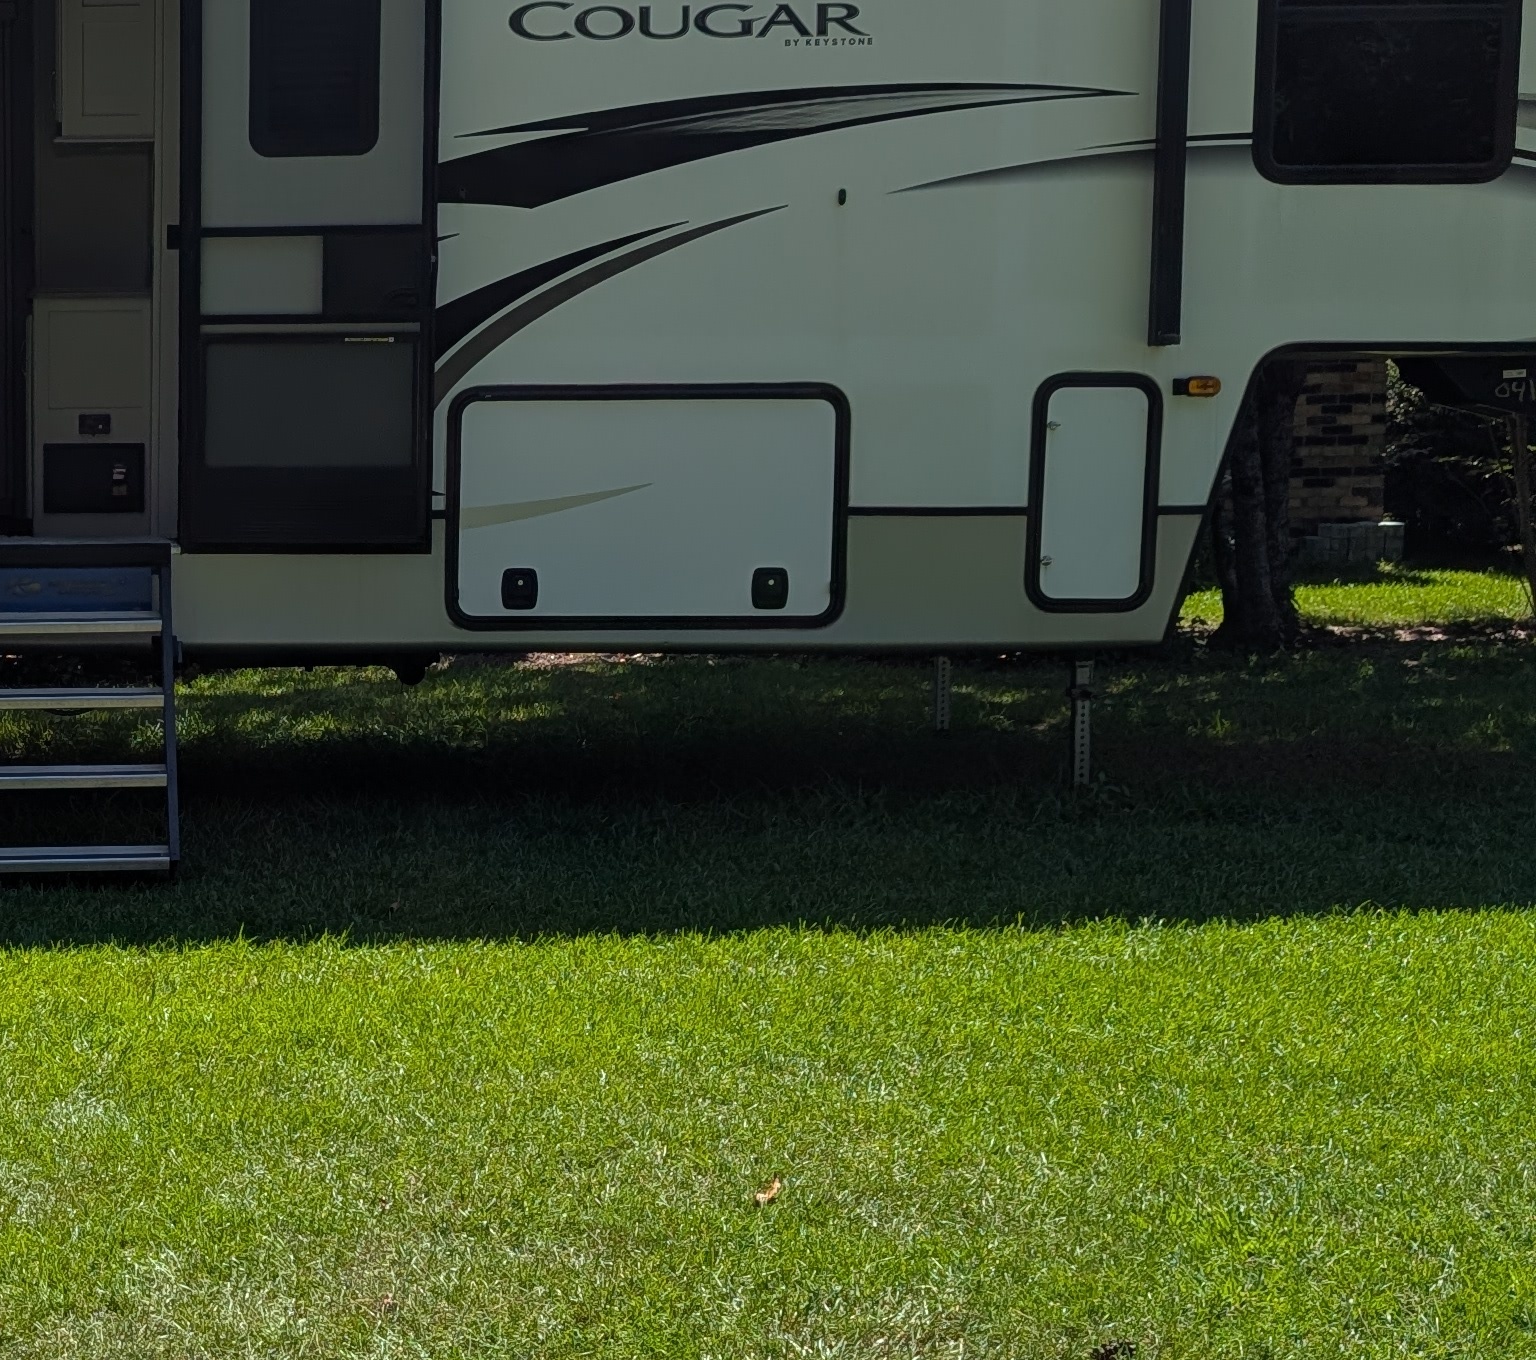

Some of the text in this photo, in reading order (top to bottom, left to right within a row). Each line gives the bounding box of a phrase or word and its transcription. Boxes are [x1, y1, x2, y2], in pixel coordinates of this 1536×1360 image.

[508, 0, 871, 42] COUGAR
[784, 37, 873, 47] BY KEYSTONE
